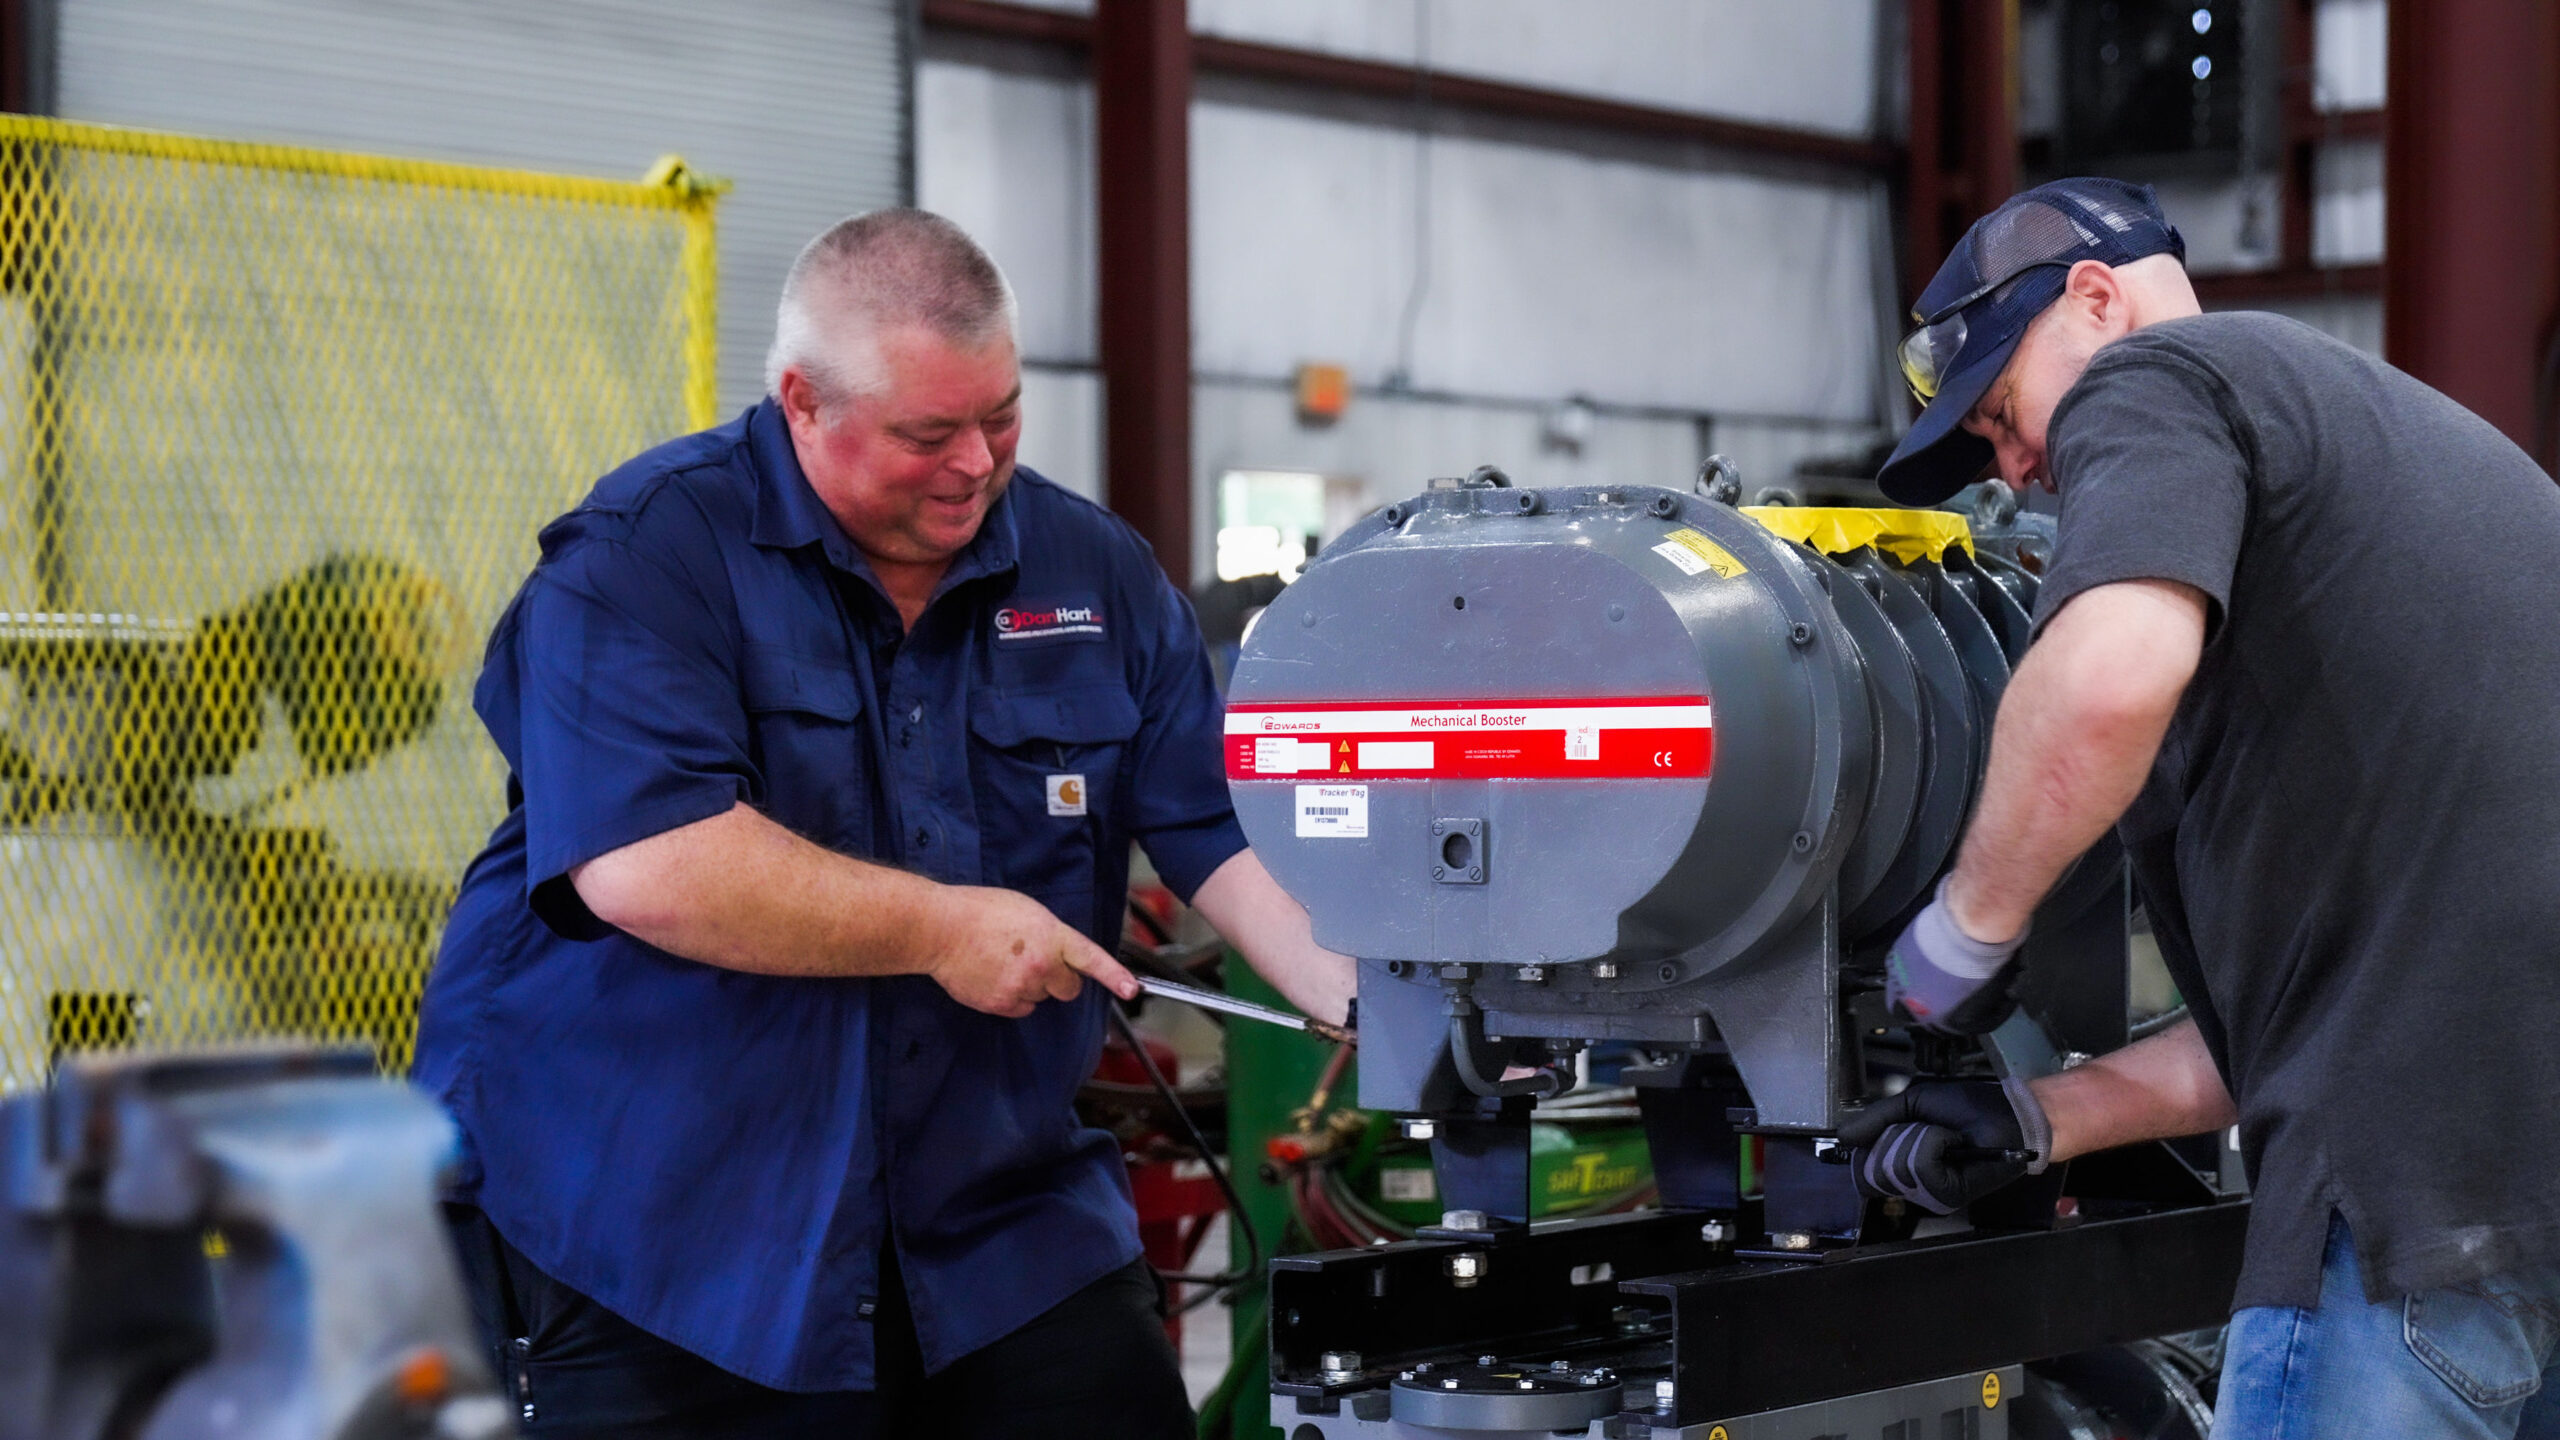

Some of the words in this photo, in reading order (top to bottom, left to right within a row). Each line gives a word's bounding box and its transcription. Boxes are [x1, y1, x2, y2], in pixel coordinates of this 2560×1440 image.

[1021, 607, 1092, 626] DanHart
[1264, 721, 1321, 731] EDWARDS
[1410, 714, 1477, 727] Mechanical
[1481, 713, 1527, 726] Booster
[1653, 751, 1672, 767] CE
[1319, 788, 1349, 797] Tracker
[1350, 788, 1365, 799] Tag
